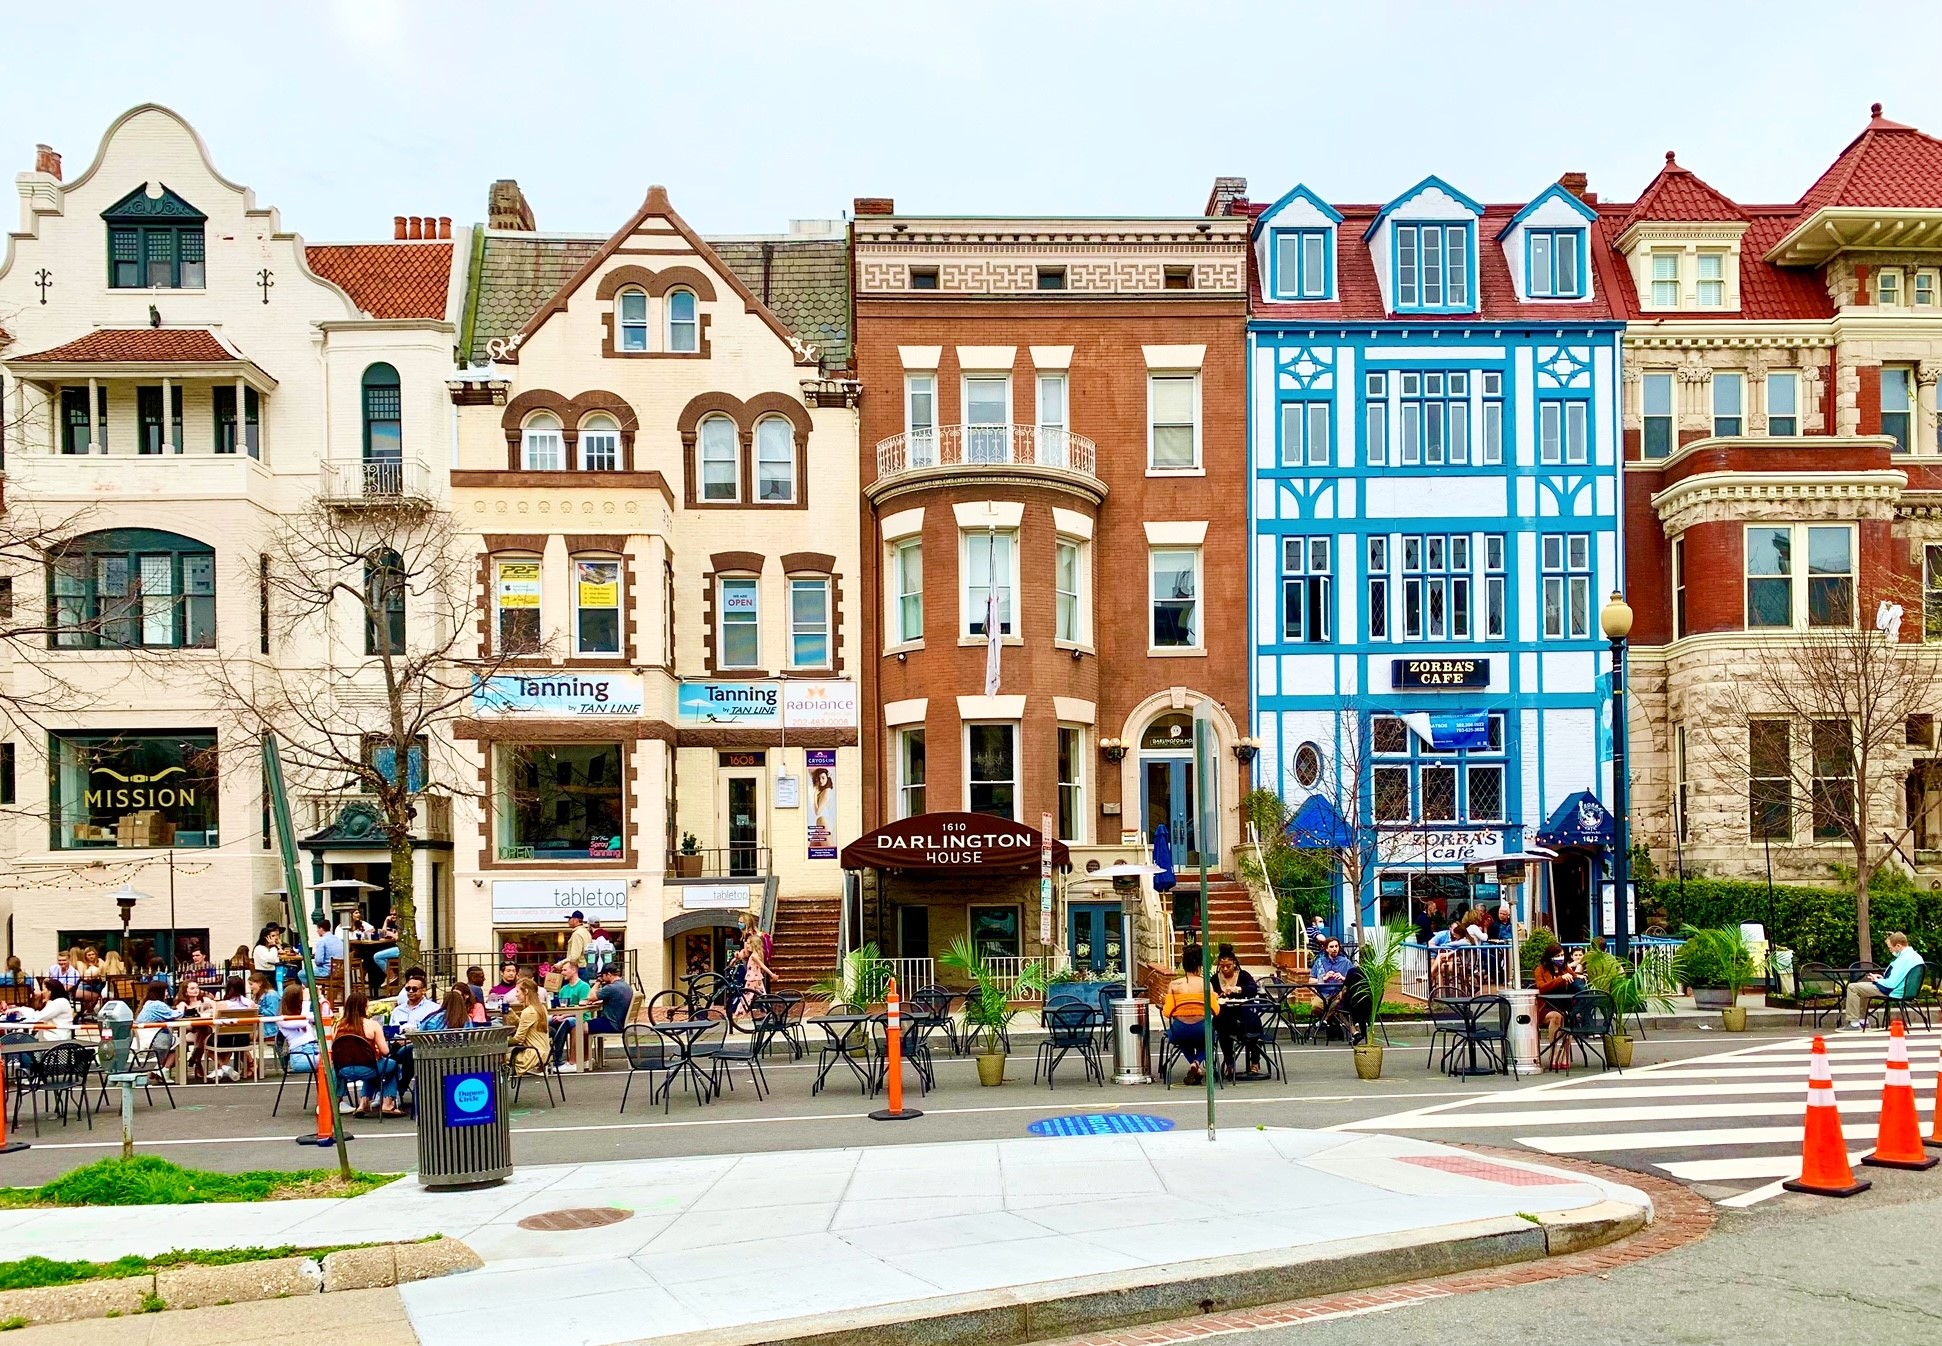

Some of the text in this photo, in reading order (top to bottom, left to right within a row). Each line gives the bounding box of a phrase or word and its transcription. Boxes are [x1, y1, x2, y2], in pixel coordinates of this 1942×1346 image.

[502, 565, 539, 574] P2P
[1409, 661, 1474, 672] ZORBA'S
[1420, 673, 1463, 684] CAFE
[514, 677, 609, 702] Tanning
[705, 686, 777, 705] Tanning
[580, 704, 607, 713] TAN
[610, 704, 641, 713] LINE
[731, 706, 752, 714] TAN
[754, 706, 777, 714] LINE
[730, 755, 755, 765] 1608
[84, 788, 195, 808] MISSION
[942, 823, 966, 831] 1610
[877, 833, 1031, 849] DARLINGTON
[1413, 832, 1497, 847] ZORBA'S
[500, 846, 533, 859] OPEN
[926, 851, 982, 864] HOUSE
[1432, 845, 1475, 859] café
[554, 887, 626, 909] tabletop
[713, 890, 749, 901] tabletop
[1086, 1115, 1113, 1133] WELCOM
